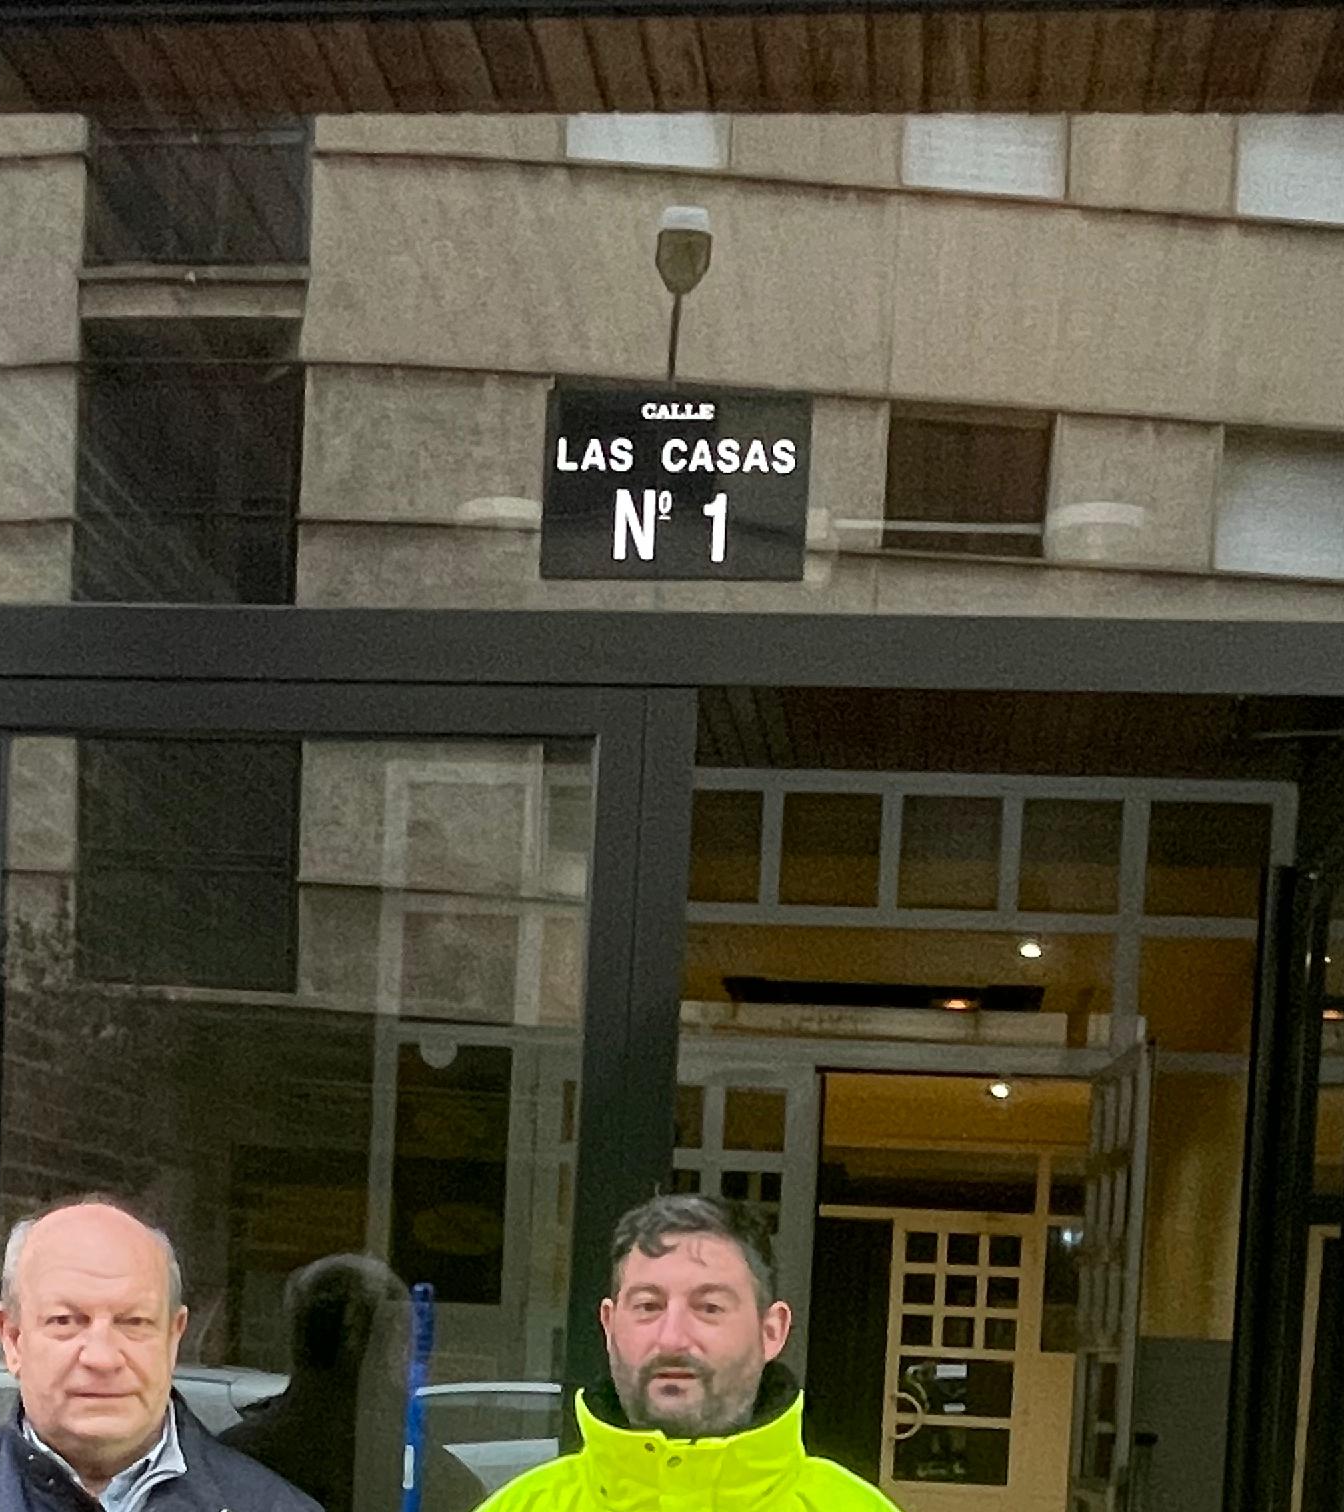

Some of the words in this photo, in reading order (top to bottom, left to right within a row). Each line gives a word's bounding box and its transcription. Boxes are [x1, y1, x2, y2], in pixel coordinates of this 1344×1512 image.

[641, 402, 716, 420] CALLE
[556, 437, 634, 472] LAS
[661, 438, 797, 474] CASAS
[702, 492, 729, 563] 1
